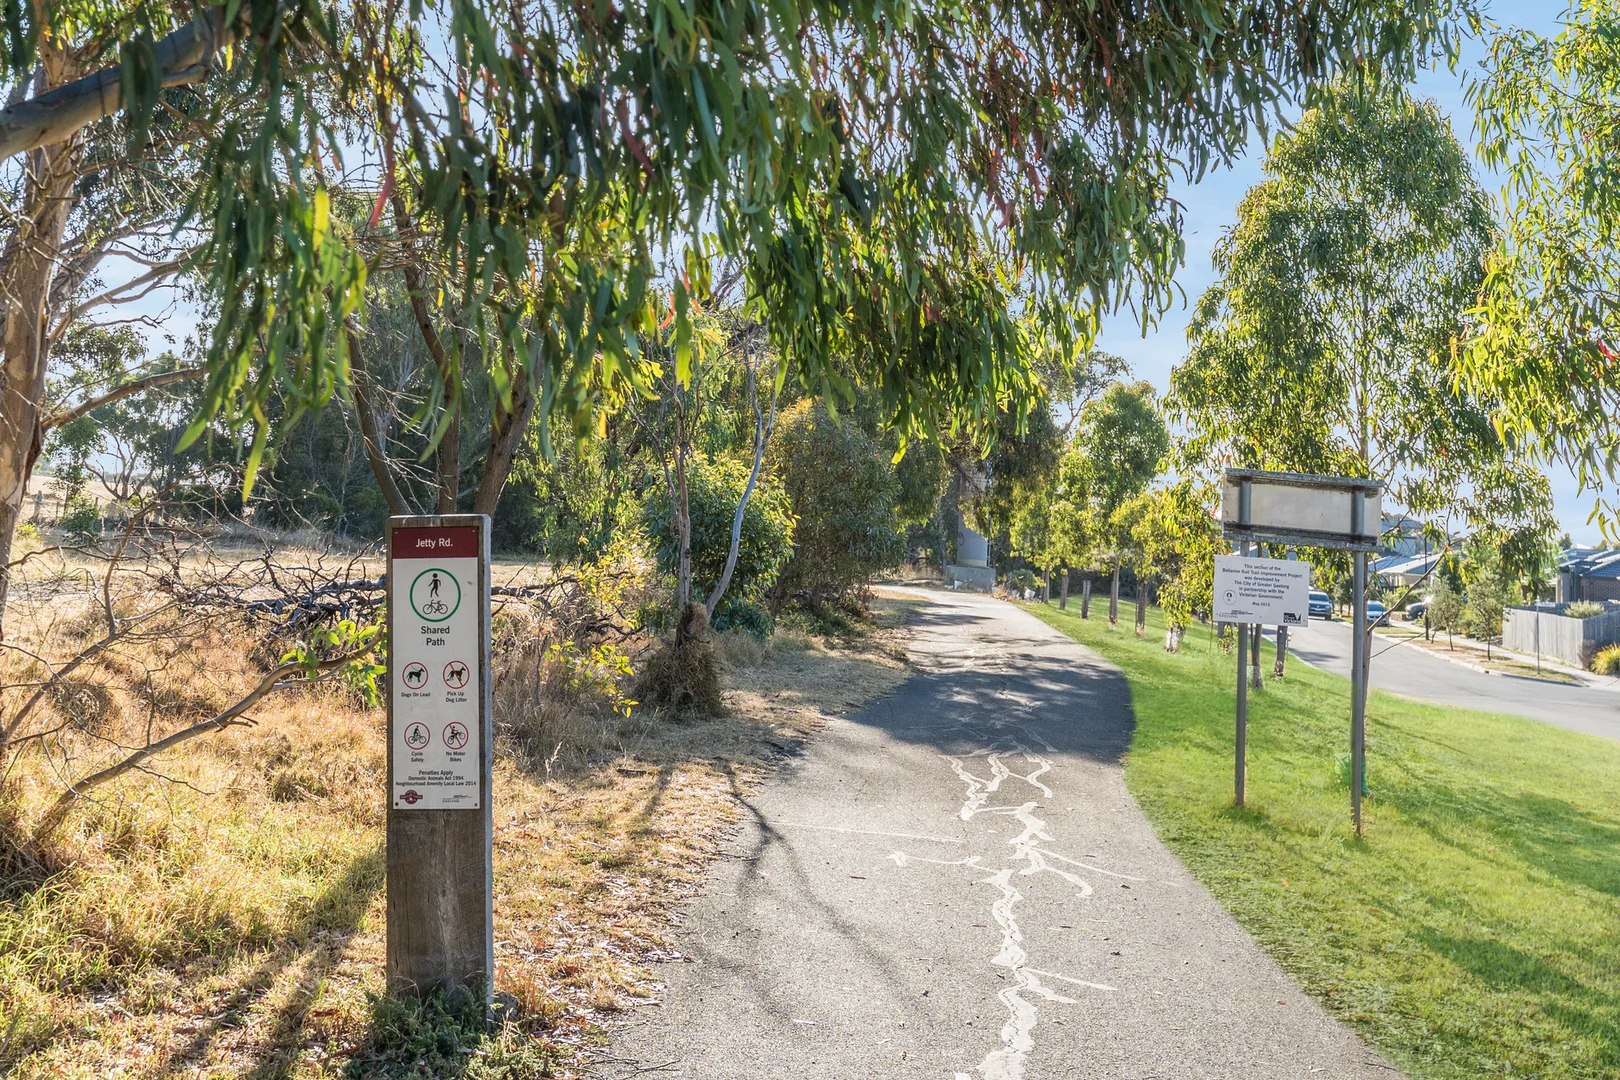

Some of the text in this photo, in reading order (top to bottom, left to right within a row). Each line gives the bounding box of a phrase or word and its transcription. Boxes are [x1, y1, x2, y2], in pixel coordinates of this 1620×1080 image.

[416, 538, 453, 549] Jetty Rd.
[421, 626, 450, 634] Shared
[426, 638, 445, 646] Path
